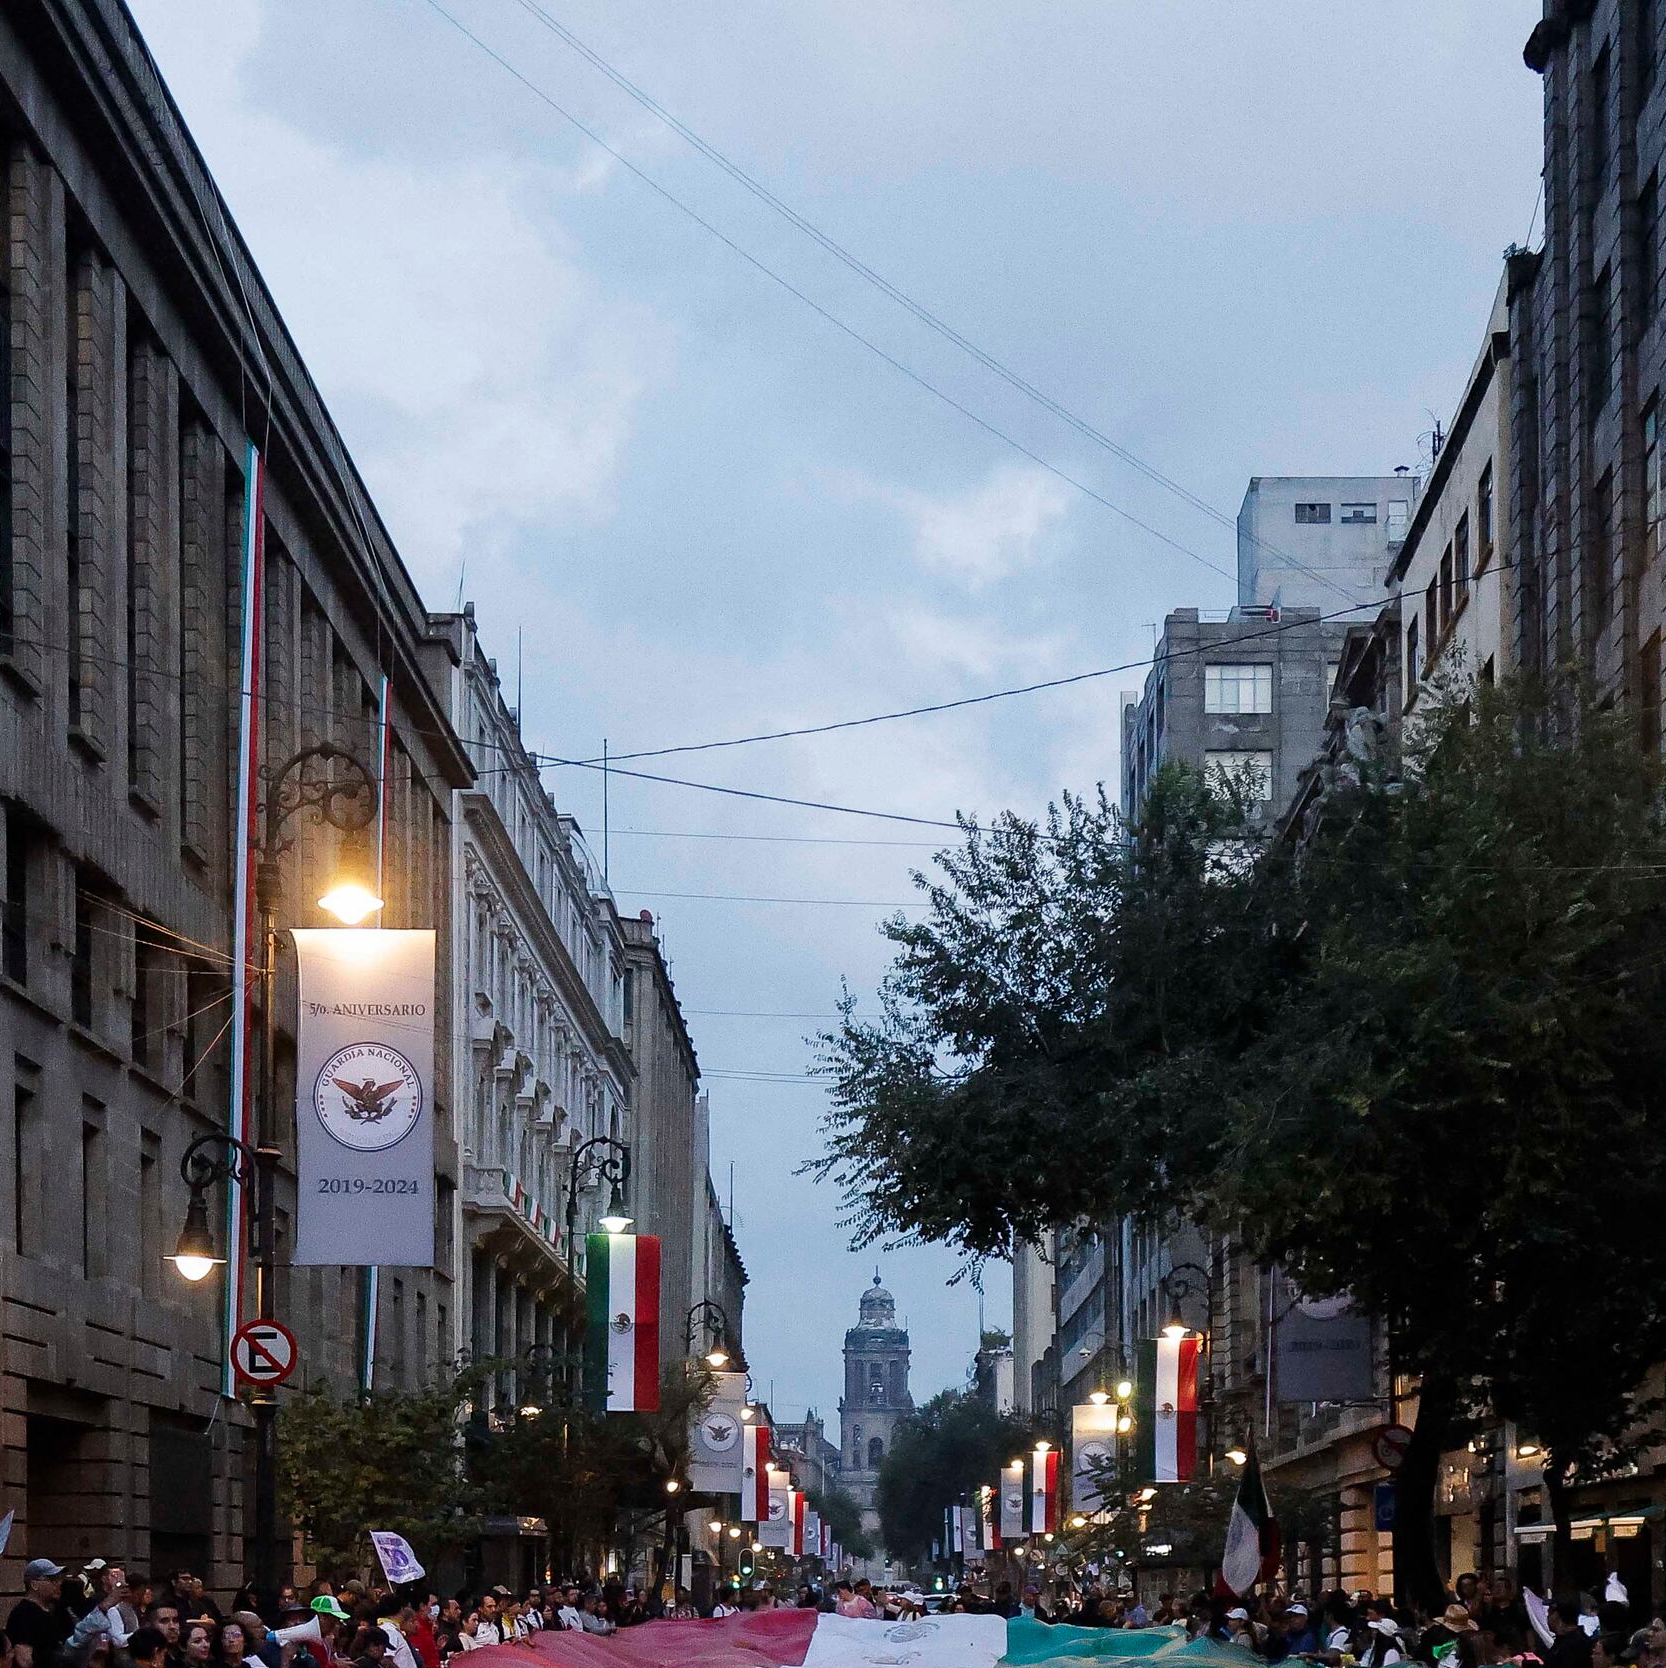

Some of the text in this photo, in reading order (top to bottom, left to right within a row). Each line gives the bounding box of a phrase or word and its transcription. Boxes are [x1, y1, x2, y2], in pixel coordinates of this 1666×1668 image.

[333, 1003, 426, 1016] ANIVERSARIO
[321, 1047, 415, 1089] GUARDIA NACIONAL
[319, 1178, 419, 1195] 2019-2024
